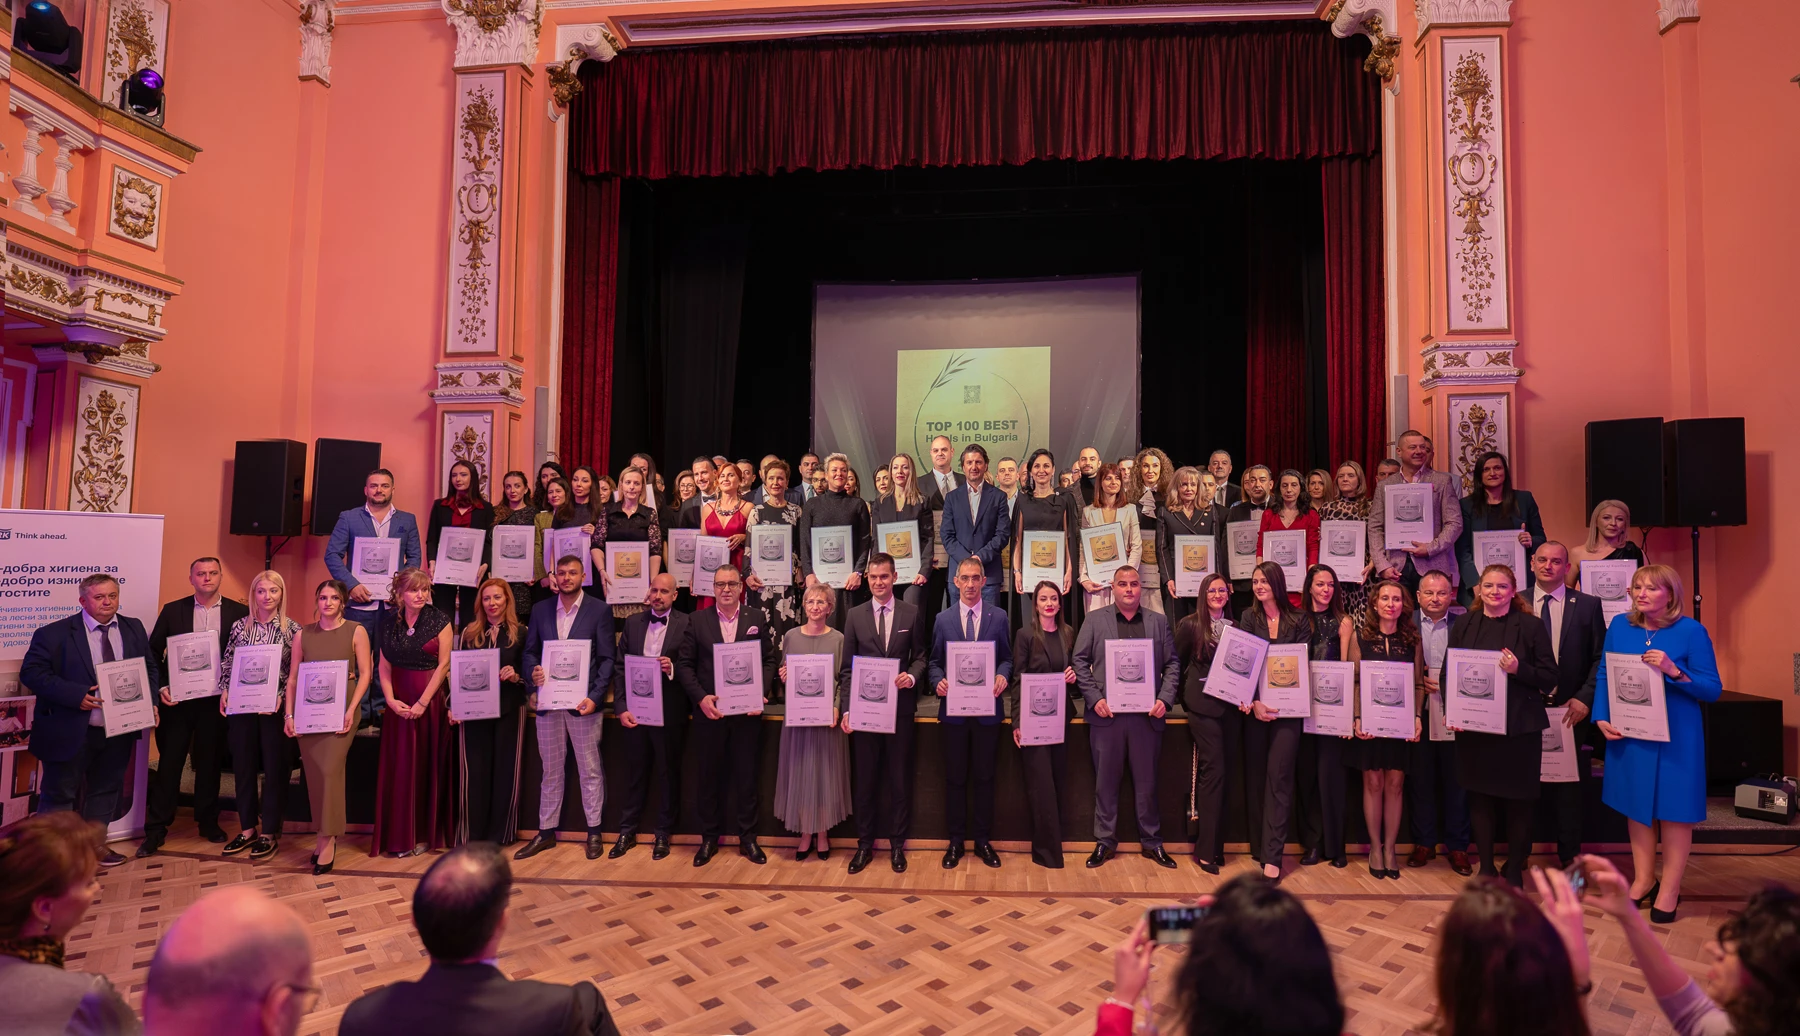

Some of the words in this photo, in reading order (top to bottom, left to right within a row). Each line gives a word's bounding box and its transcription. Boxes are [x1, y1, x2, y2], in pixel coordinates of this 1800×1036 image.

[926, 422, 952, 432] TOP
[956, 421, 980, 430] 100
[984, 420, 1018, 430] BEST
[962, 434, 970, 442] in
[974, 432, 1018, 443] Bulgaria
